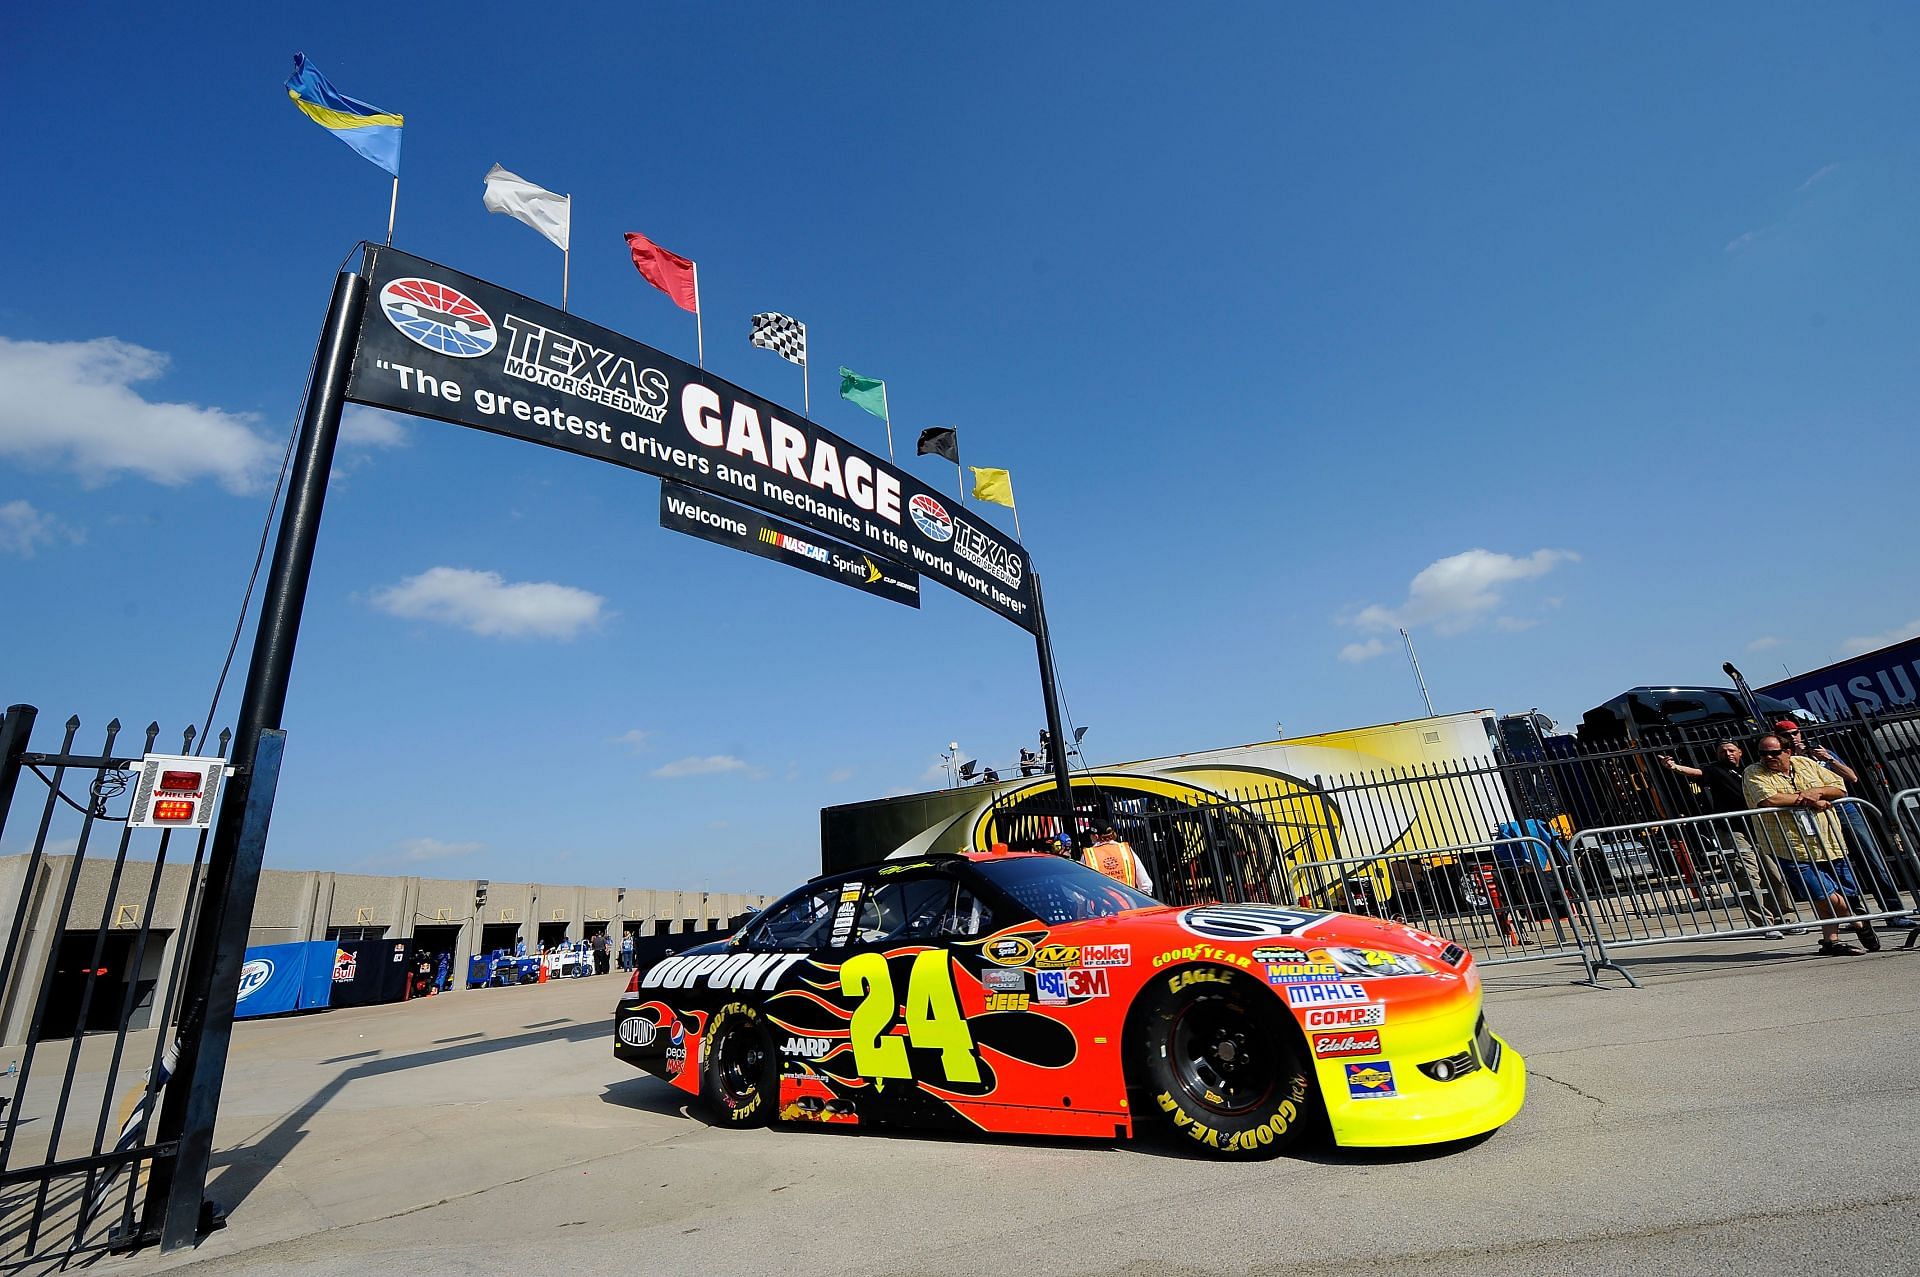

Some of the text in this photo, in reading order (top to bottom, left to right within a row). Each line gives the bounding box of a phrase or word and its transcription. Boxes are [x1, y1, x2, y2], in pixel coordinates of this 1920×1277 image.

[503, 314, 669, 410] TEXAS
[504, 359, 668, 423] MOTOR SPEEDWAY
[681, 382, 901, 526] GARAGE
[474, 388, 611, 444] greatest
[620, 429, 709, 475] drivers
[716, 463, 757, 492] and
[763, 482, 861, 532] mechanics
[865, 520, 880, 541] in
[882, 527, 908, 553] the
[912, 544, 953, 576] world
[956, 567, 989, 596] work
[666, 496, 747, 536] Welcome
[782, 534, 829, 563] NASCAR
[833, 555, 866, 577] Sprint
[954, 516, 1022, 580] TEXAS
[954, 542, 1020, 590] MOTOR SPEEDWAY
[1783, 660, 1920, 722] MSU
[153, 790, 203, 799] WHELEN
[1084, 946, 1129, 964] Holley
[1152, 943, 1252, 968] GOODYEAR
[1362, 950, 1397, 966] 24
[333, 965, 356, 979] Bull
[641, 952, 809, 990] DUPONT
[1168, 968, 1235, 994] EAGLE
[1269, 964, 1336, 976] MOOG
[1038, 970, 1107, 997] USG 3M
[1288, 984, 1367, 1003] MAHLE
[985, 993, 1030, 1011] JEGS
[840, 949, 981, 1083] 24
[1310, 1009, 1365, 1025] COMP
[780, 1037, 830, 1057] AARP
[1316, 1036, 1380, 1053] Edelbrock
[1349, 1072, 1392, 1085] SUNOCO
[732, 1092, 762, 1121] EAGLE
[1157, 1090, 1297, 1151] GOODYEAR
